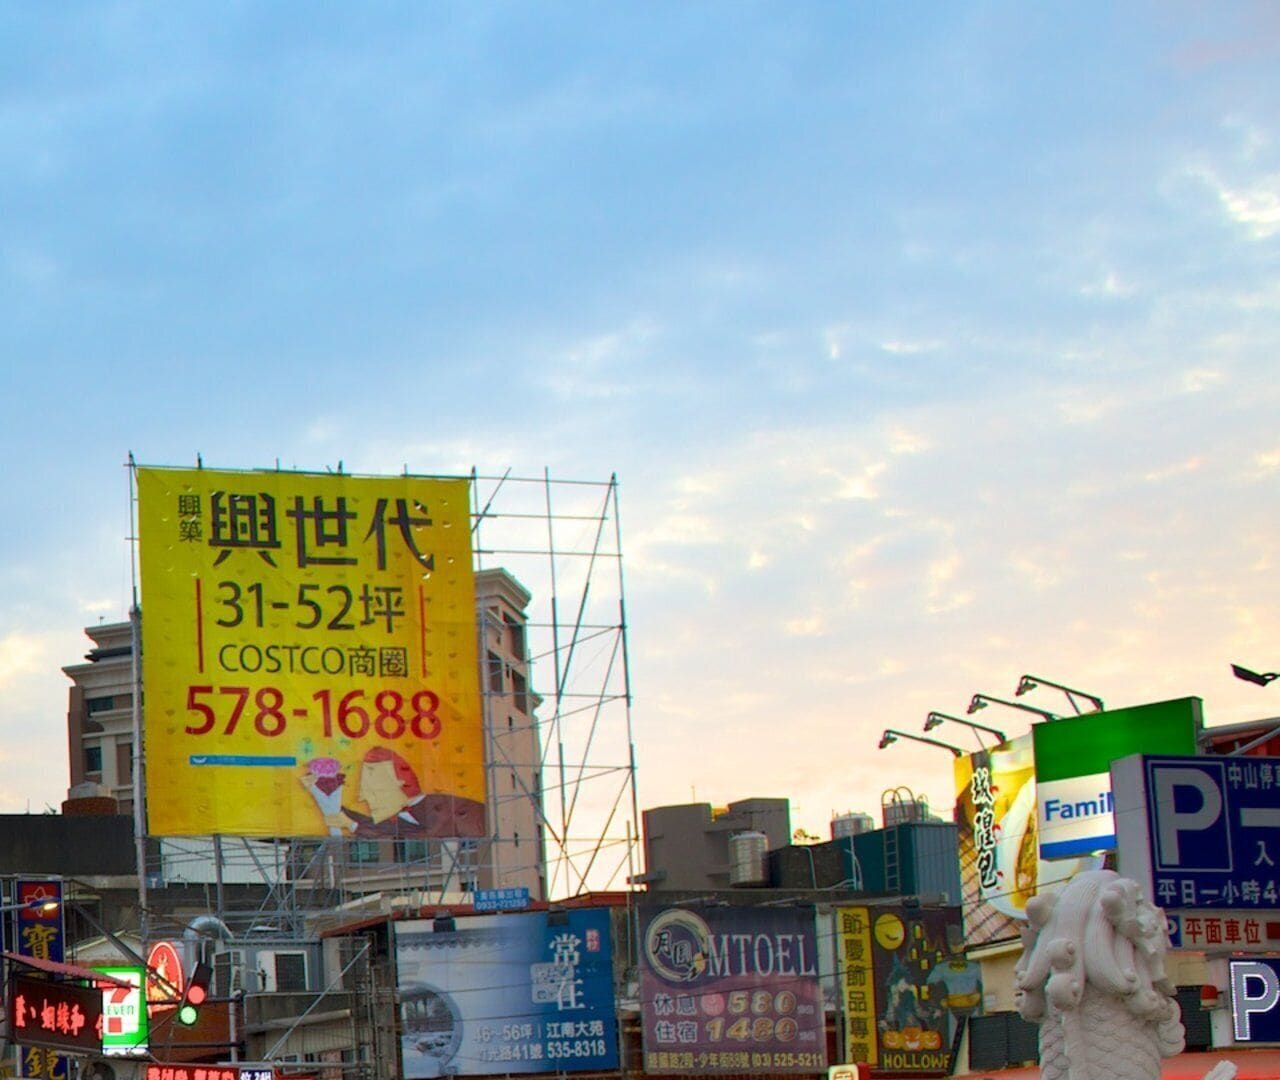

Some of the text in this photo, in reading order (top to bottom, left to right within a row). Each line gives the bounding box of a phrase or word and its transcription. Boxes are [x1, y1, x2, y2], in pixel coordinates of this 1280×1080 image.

[208, 490, 435, 571] 興世代
[216, 581, 406, 634] 31-52坪
[219, 643, 409, 679] COSTCO商圈
[184, 685, 443, 741] 578-1688
[1228, 762, 1280, 790] 中山停
[1044, 792, 1115, 822] Famil
[1153, 767, 1223, 866] P
[1157, 878, 1280, 905] 平日一小時4
[1185, 917, 1262, 945] 平面車位
[707, 933, 817, 977] MTOEL
[1231, 961, 1280, 1041] P
[654, 1016, 800, 1044] 住宿 1480
[547, 1039, 606, 1059] 535-8318
[773, 1052, 825, 1068] 525-5211
